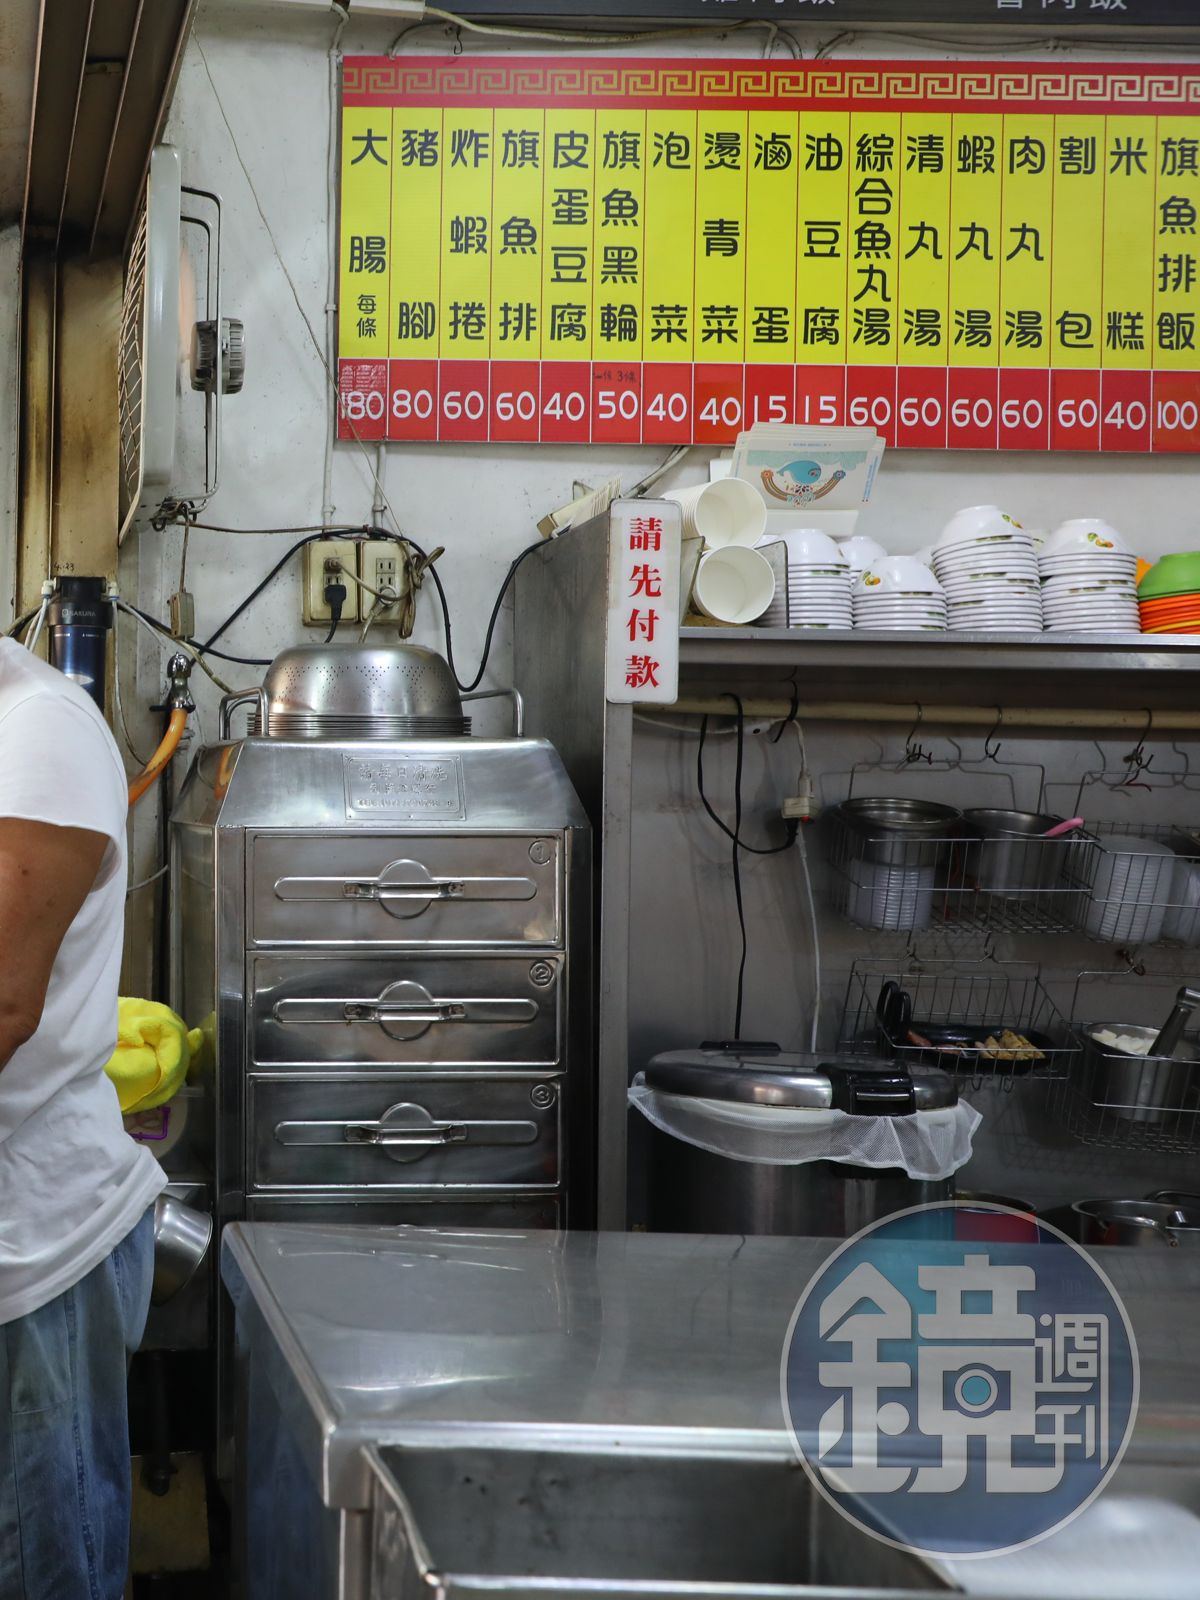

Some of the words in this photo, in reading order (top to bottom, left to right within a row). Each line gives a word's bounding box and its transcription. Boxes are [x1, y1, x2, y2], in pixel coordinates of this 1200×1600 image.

[349, 129, 388, 274] 大腸
[449, 130, 490, 340] 炸蝦捲
[500, 130, 540, 342] 旗魚排
[550, 131, 589, 342] 皮蛋豆腐
[600, 131, 641, 342] 旗魚黑輪
[702, 132, 741, 344] 燙青菜
[803, 133, 843, 346] 油豆腐
[853, 134, 895, 346] 綜合魚丸湯
[904, 134, 945, 347] 清丸湯
[955, 135, 995, 348] 蝦丸湯
[1005, 136, 1046, 349] 肉丸湯
[1157, 137, 1200, 351] 旗魚排飯
[356, 294, 377, 338] 每條
[341, 390, 385, 420] 180
[392, 389, 433, 419] 80
[443, 391, 484, 420] 60
[495, 391, 536, 421] 60
[543, 392, 585, 421] 40
[598, 390, 639, 420] 50
[646, 393, 688, 422] 40
[700, 397, 742, 426] 40
[804, 396, 837, 424] 15
[850, 397, 891, 426] 60
[900, 398, 941, 427] 60
[952, 399, 993, 428] 60
[1002, 400, 1043, 428] 60
[1058, 400, 1098, 428] 60
[1105, 402, 1147, 430] 40
[1158, 401, 1198, 430] 100
[625, 517, 663, 689] 請先付款
